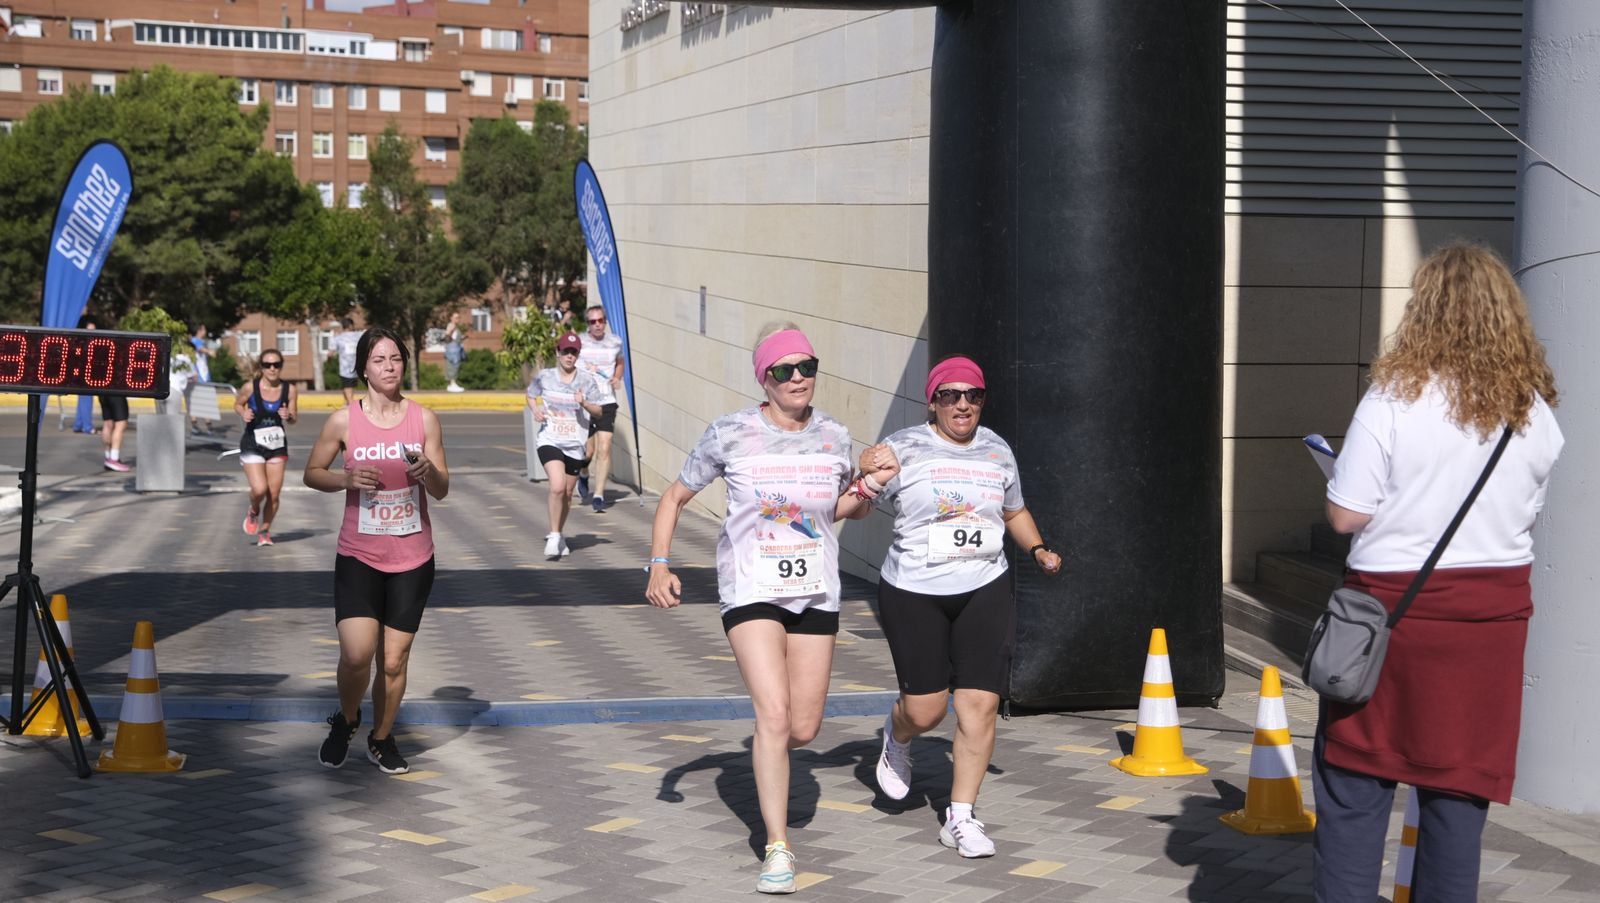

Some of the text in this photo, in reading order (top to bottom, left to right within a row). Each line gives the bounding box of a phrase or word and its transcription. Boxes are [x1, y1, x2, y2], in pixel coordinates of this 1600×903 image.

[0, 334, 156, 389] 30:08
[370, 502, 414, 520] 1029
[953, 529, 983, 548] 94
[778, 558, 808, 578] 93
